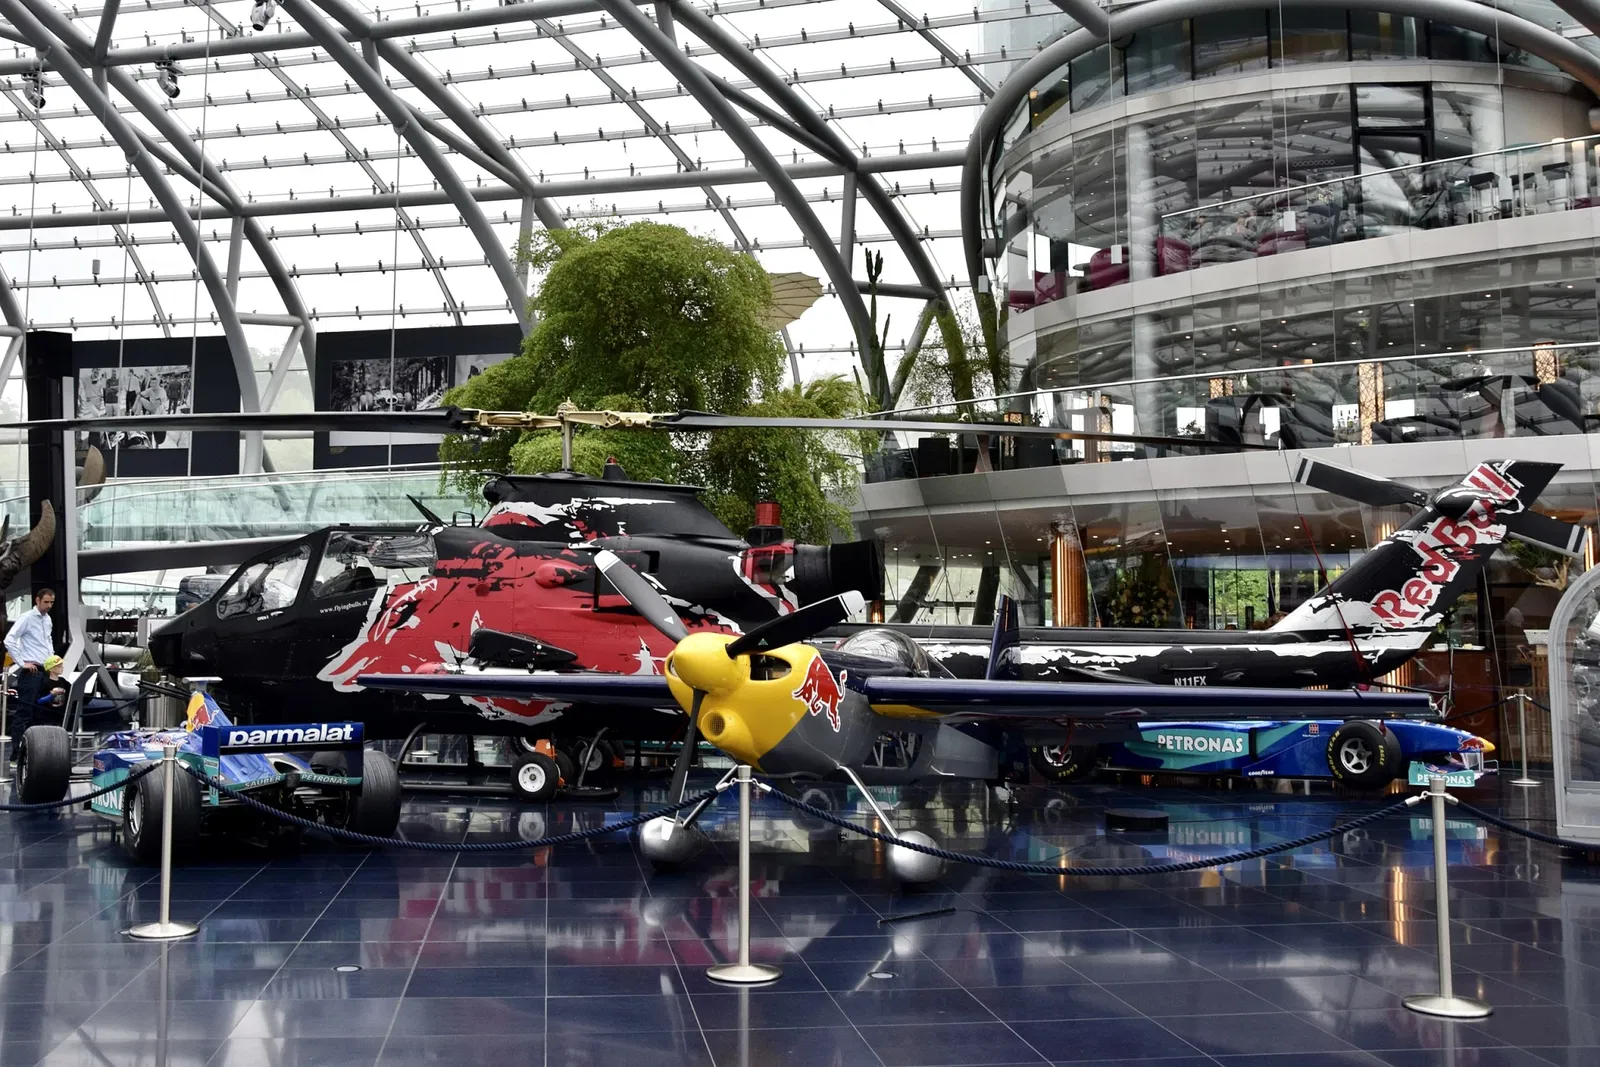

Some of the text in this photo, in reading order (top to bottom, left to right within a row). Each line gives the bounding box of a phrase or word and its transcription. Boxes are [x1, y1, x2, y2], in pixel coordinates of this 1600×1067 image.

[1371, 540, 1457, 628] Red
[319, 600, 368, 614] www.flyingbulls.at
[1174, 676, 1207, 686] N11FX
[228, 724, 354, 746] parmalat
[1158, 735, 1243, 753] PETRONAS
[244, 775, 282, 788] SAUBER
[301, 774, 349, 785] PETRONAS
